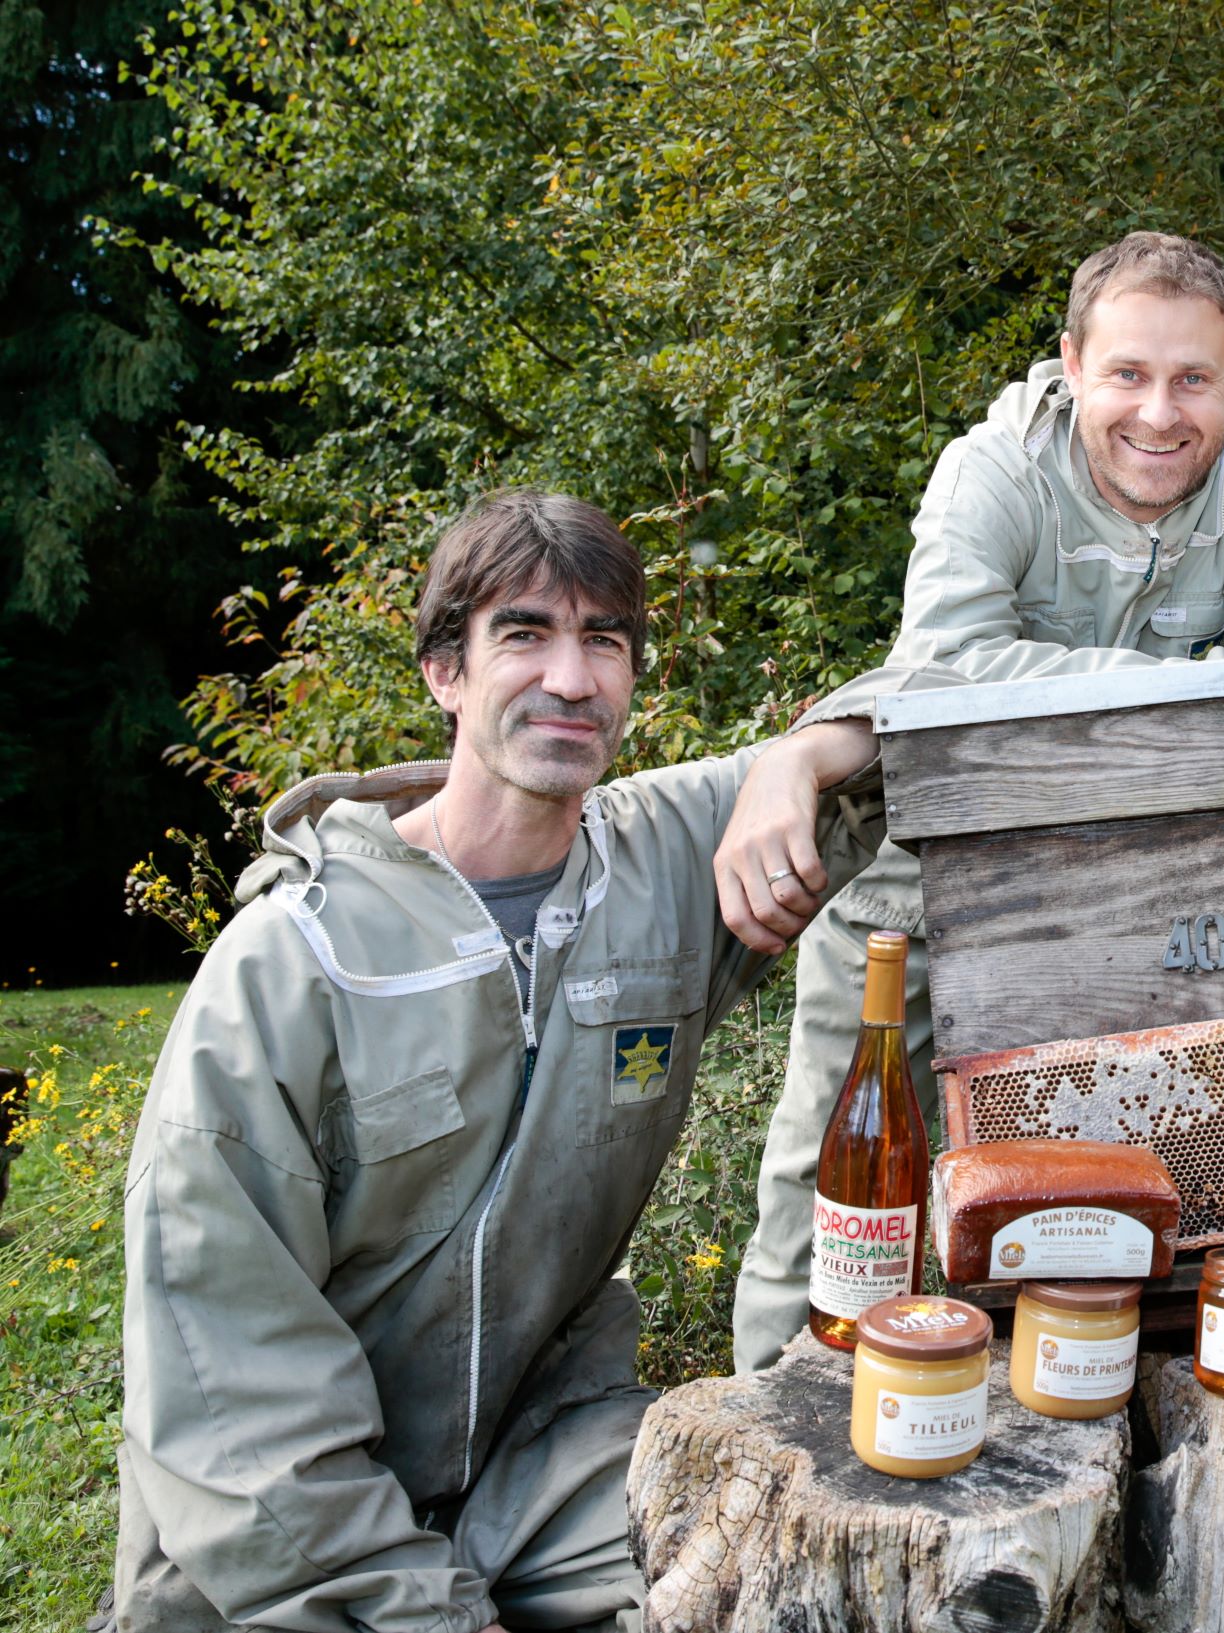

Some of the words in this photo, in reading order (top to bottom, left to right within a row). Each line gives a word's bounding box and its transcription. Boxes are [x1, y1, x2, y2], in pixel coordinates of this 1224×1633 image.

[1032, 1211, 1062, 1228] PAIN
[1065, 1208, 1117, 1226] D'ÉPICES
[1039, 1227, 1109, 1237] ARTISANAL
[822, 1237, 909, 1259] ARTISANAL
[821, 1255, 868, 1276] VIEUX
[836, 1275, 850, 1285] Miels
[861, 1279, 878, 1287] Vexin
[894, 1275, 906, 1285] Midi
[885, 1312, 969, 1331] Miels
[1042, 1360, 1080, 1376] FLEURS
[1083, 1366, 1096, 1376] DE
[909, 1414, 977, 1435] TILLEUL
[933, 1414, 950, 1422] MIEL
[952, 1411, 960, 1420] DE
